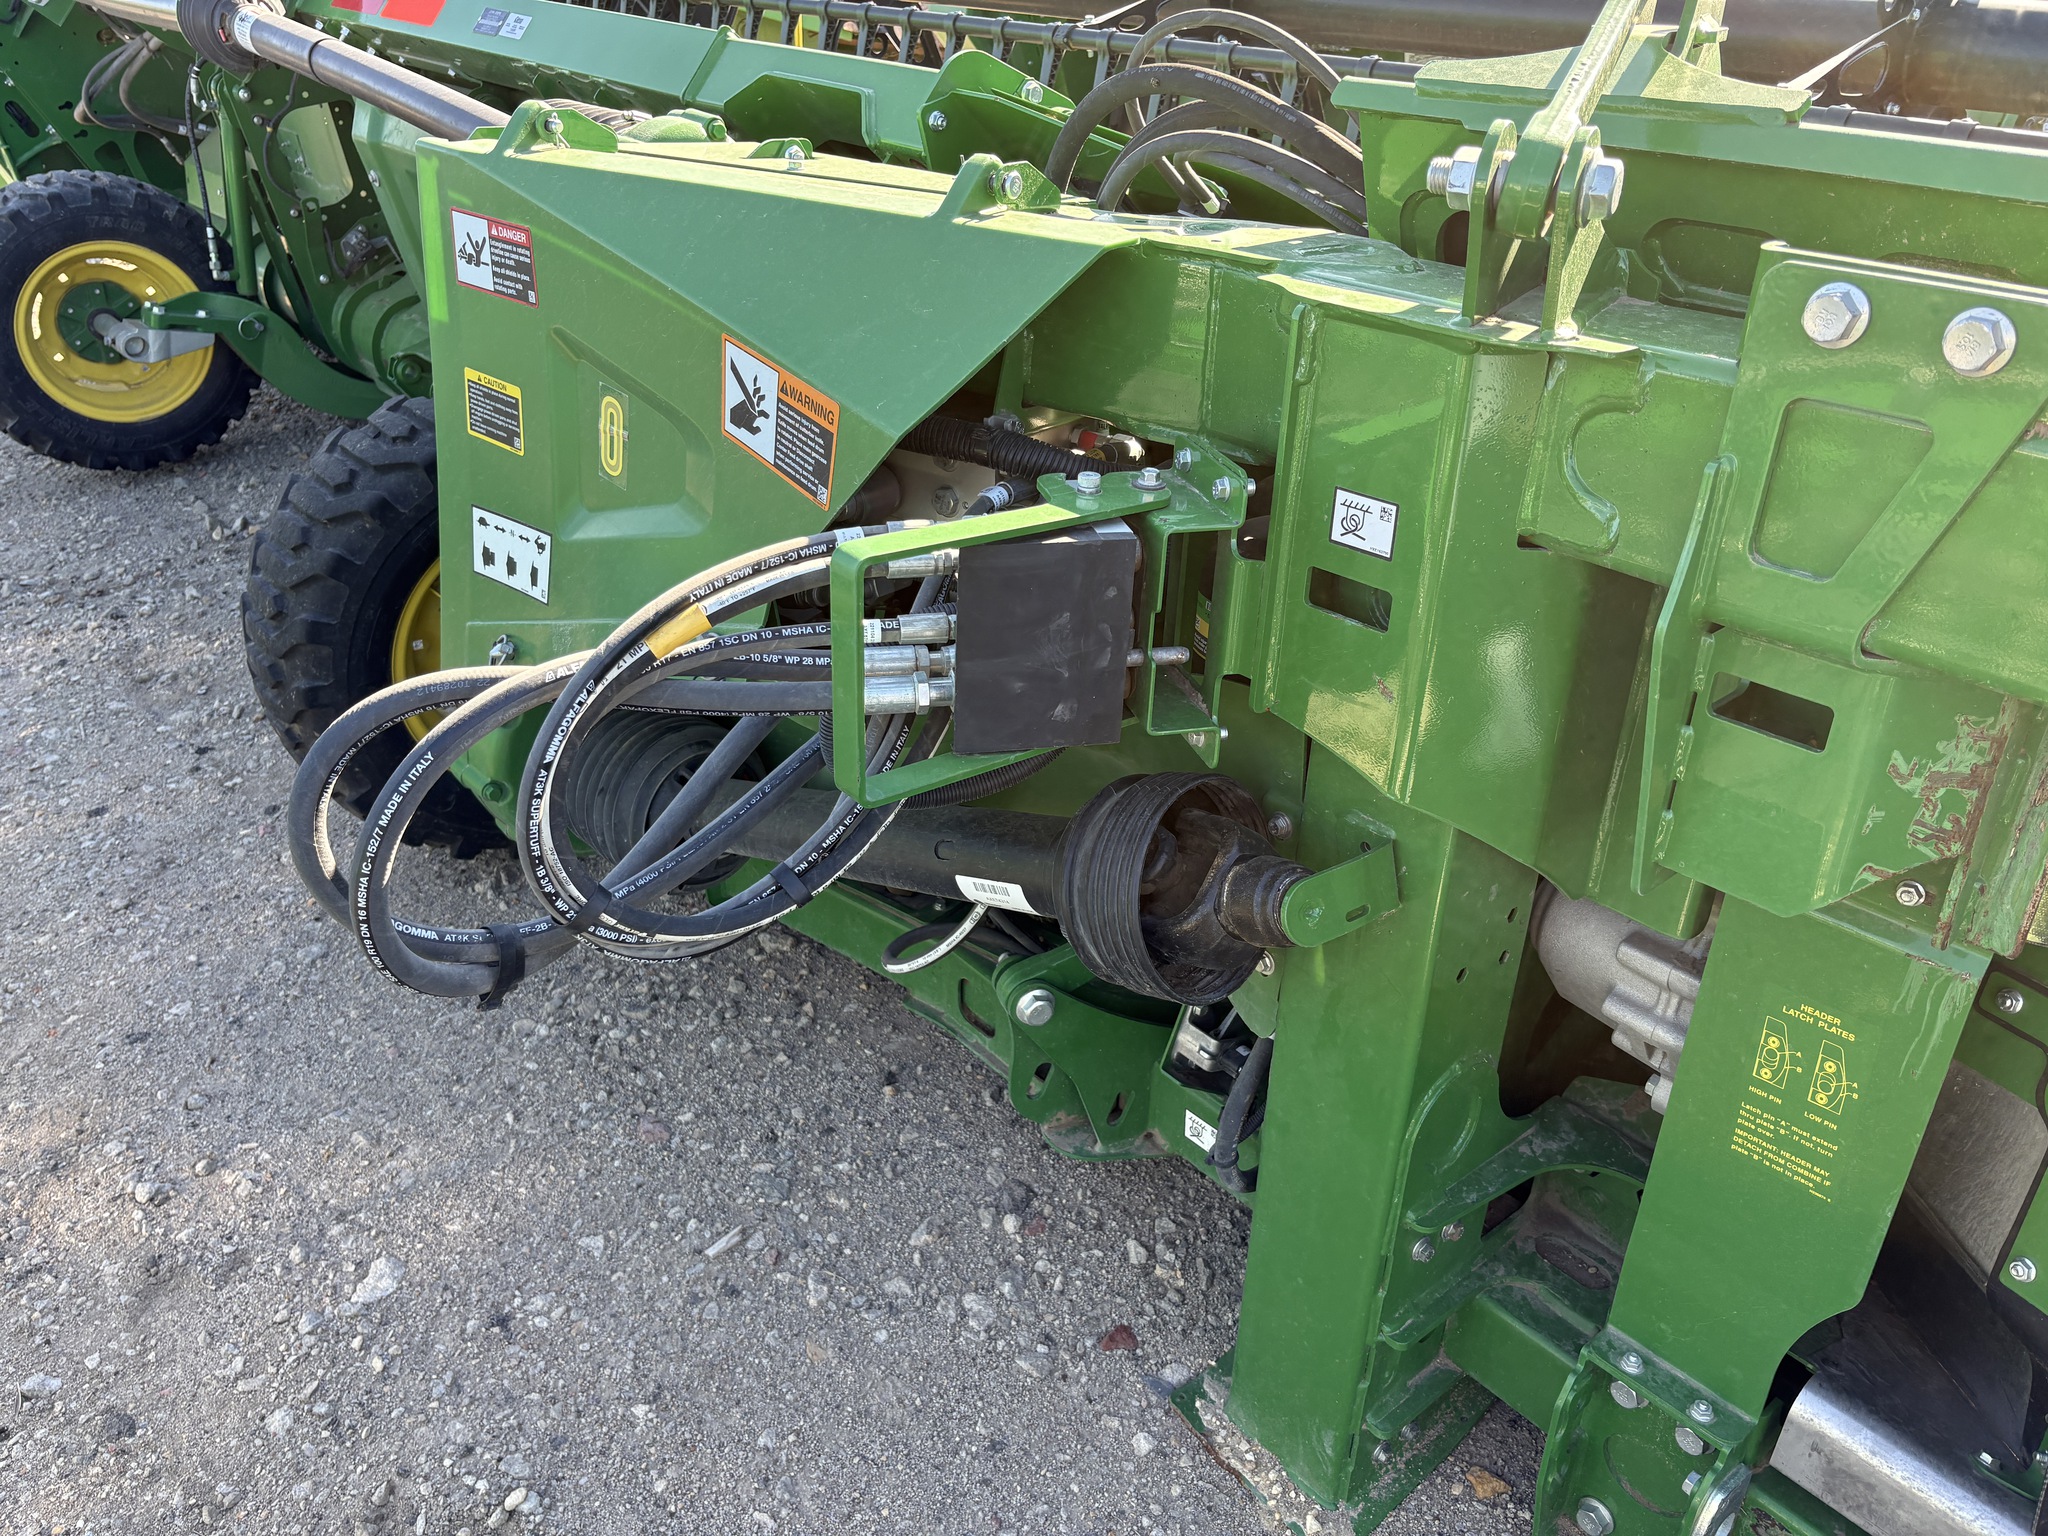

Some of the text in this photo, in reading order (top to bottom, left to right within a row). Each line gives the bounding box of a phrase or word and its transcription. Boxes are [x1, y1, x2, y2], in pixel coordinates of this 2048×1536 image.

[498, 226, 526, 243] DANGER
[484, 377, 507, 392] CAUTION
[789, 384, 834, 426] WARNING
[761, 551, 798, 570] IC-152/7
[800, 544, 827, 558] MSHA
[715, 578, 725, 589] IN
[727, 566, 752, 584] MADE
[690, 583, 714, 602] ITALY
[881, 620, 900, 629] ADE
[682, 646, 696, 658] EN
[699, 641, 716, 652] 857
[719, 636, 740, 647] 1SC
[742, 632, 759, 644] DN
[761, 630, 772, 640] 10
[782, 626, 813, 636] MSHA
[763, 654, 814, 665] 5/8" WP 28
[440, 700, 456, 709] DN
[394, 708, 424, 722] MSHA
[357, 722, 393, 746] IC-152/7
[543, 688, 590, 764] ALFAGOMMA
[334, 747, 356, 772] MADE
[408, 750, 434, 781] ITALY
[328, 772, 338, 782] IN
[534, 768, 548, 796] AT3K
[398, 780, 412, 794] IN
[794, 725, 910, 874] DN 10 MSHA IN ITALY
[378, 792, 404, 827] MADE
[530, 798, 542, 857] SUPERTUFF
[362, 827, 384, 874] IC-152/7
[535, 864, 546, 878] 1B
[358, 876, 369, 908] MSHA
[540, 877, 556, 894] 3/8"
[614, 884, 636, 900] MPa
[358, 909, 367, 920] 16
[554, 898, 569, 912] WP
[566, 910, 577, 920] 21
[360, 924, 370, 938] DN
[596, 926, 618, 940] (3000
[620, 934, 638, 943] PSI)
[380, 968, 398, 983] SAE
[1782, 1006, 1856, 1042] LATCH PLATES
[1801, 1004, 1842, 1026] HEADER
[1748, 1085, 1782, 1104] HIGH PIN
[1737, 1118, 1775, 1139] plate over.
[1742, 1102, 1838, 1151] Latch pin "A" must extend
[1804, 1111, 1837, 1130] LOW PIN
[1740, 1110, 1754, 1120] thru
[1756, 1118, 1774, 1130] plate
[1800, 1139, 1815, 1150] not,
[1817, 1147, 1833, 1158] turn
[1733, 1136, 1762, 1153] DETACH
[1764, 1150, 1785, 1165] FROM
[1786, 1163, 1822, 1182] COMBINE
[1735, 1128, 1830, 1177] IMPORTANT: HEADER MAY
[1731, 1144, 1748, 1155] plate
[1750, 1152, 1762, 1160] "B"
[1771, 1164, 1783, 1172] not
[1793, 1175, 1815, 1188] place.
